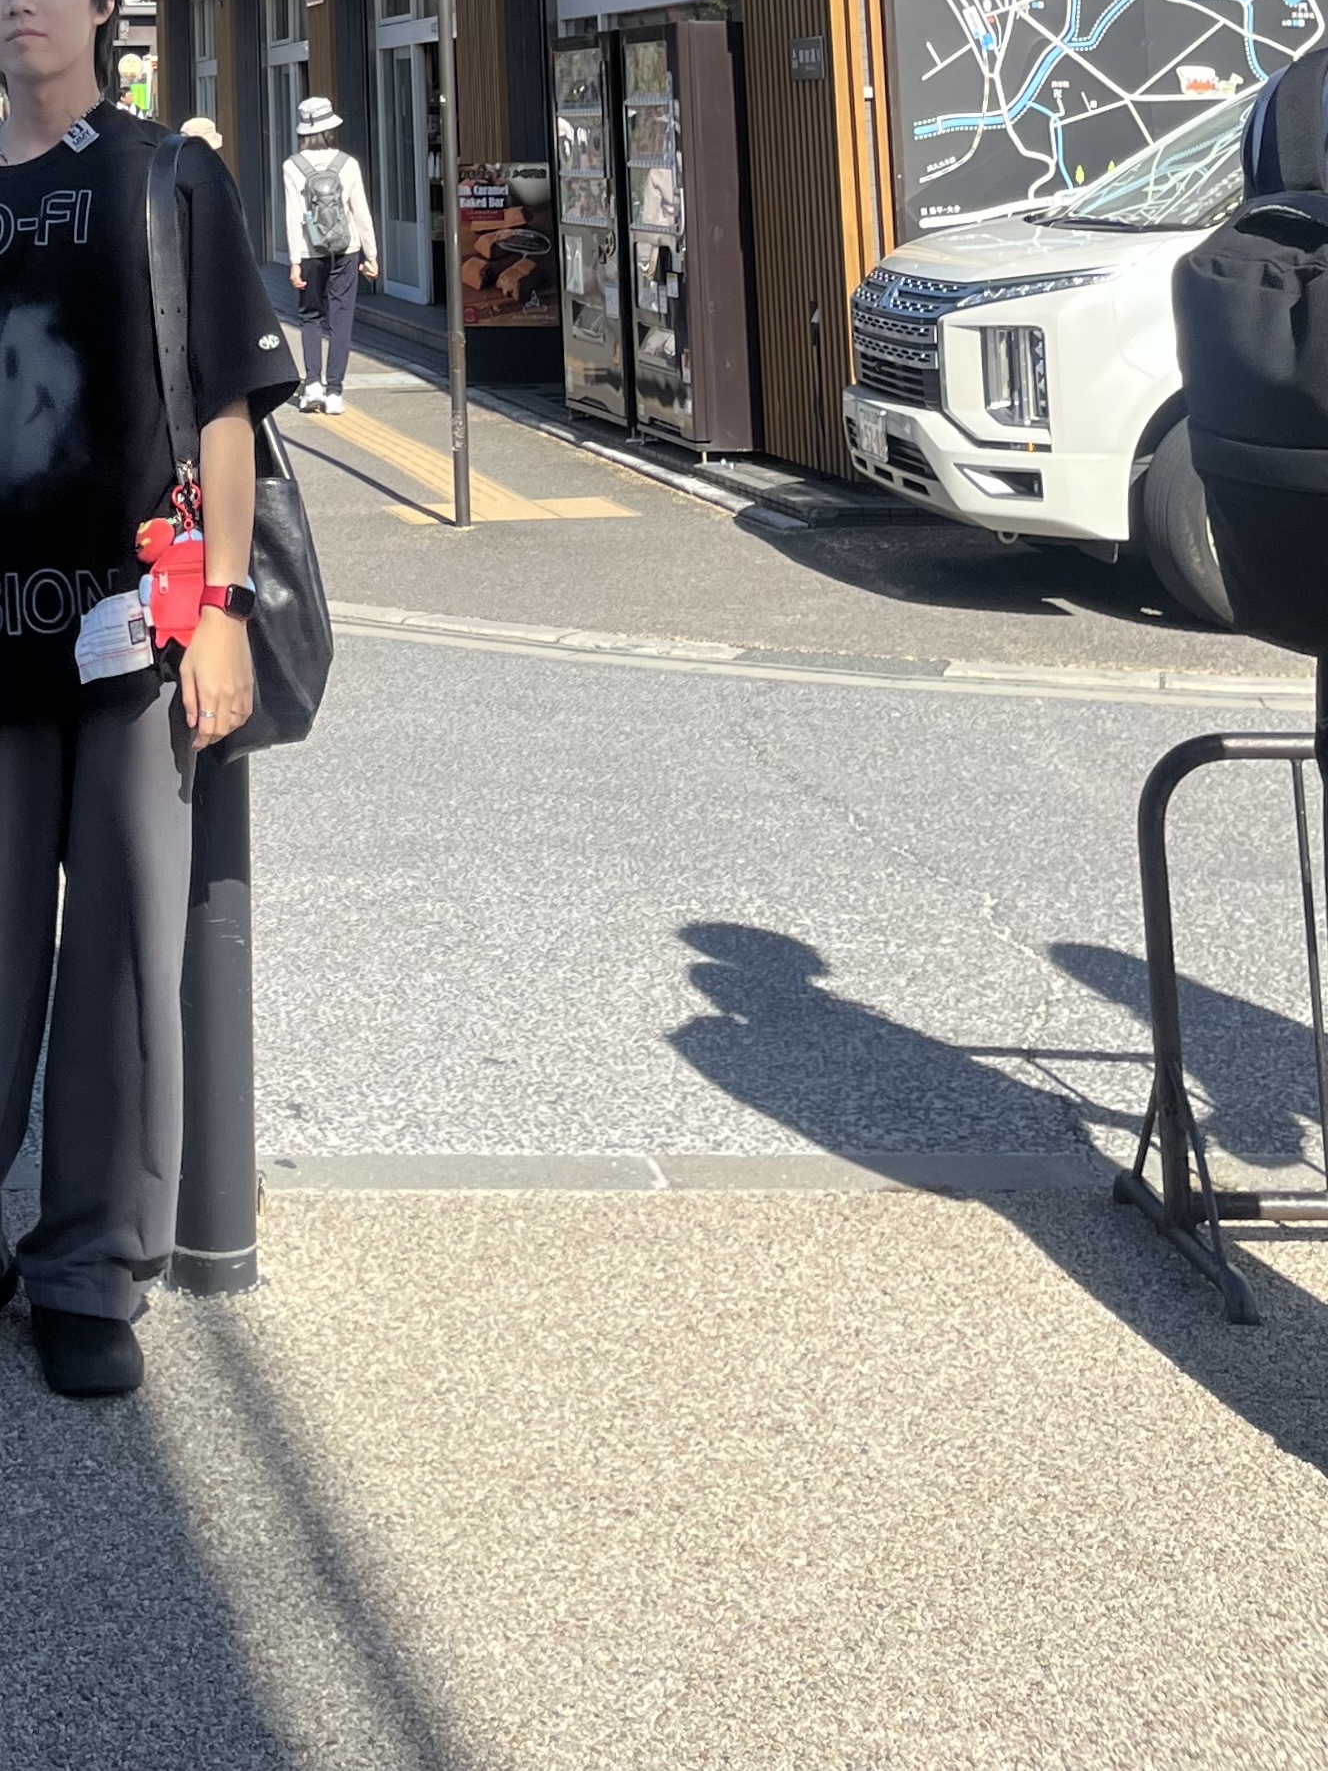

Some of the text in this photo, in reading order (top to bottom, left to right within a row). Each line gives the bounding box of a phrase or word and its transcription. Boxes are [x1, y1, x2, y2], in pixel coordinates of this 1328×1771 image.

[473, 184, 509, 196] Caramel
[459, 197, 505, 208] Baked Bar
